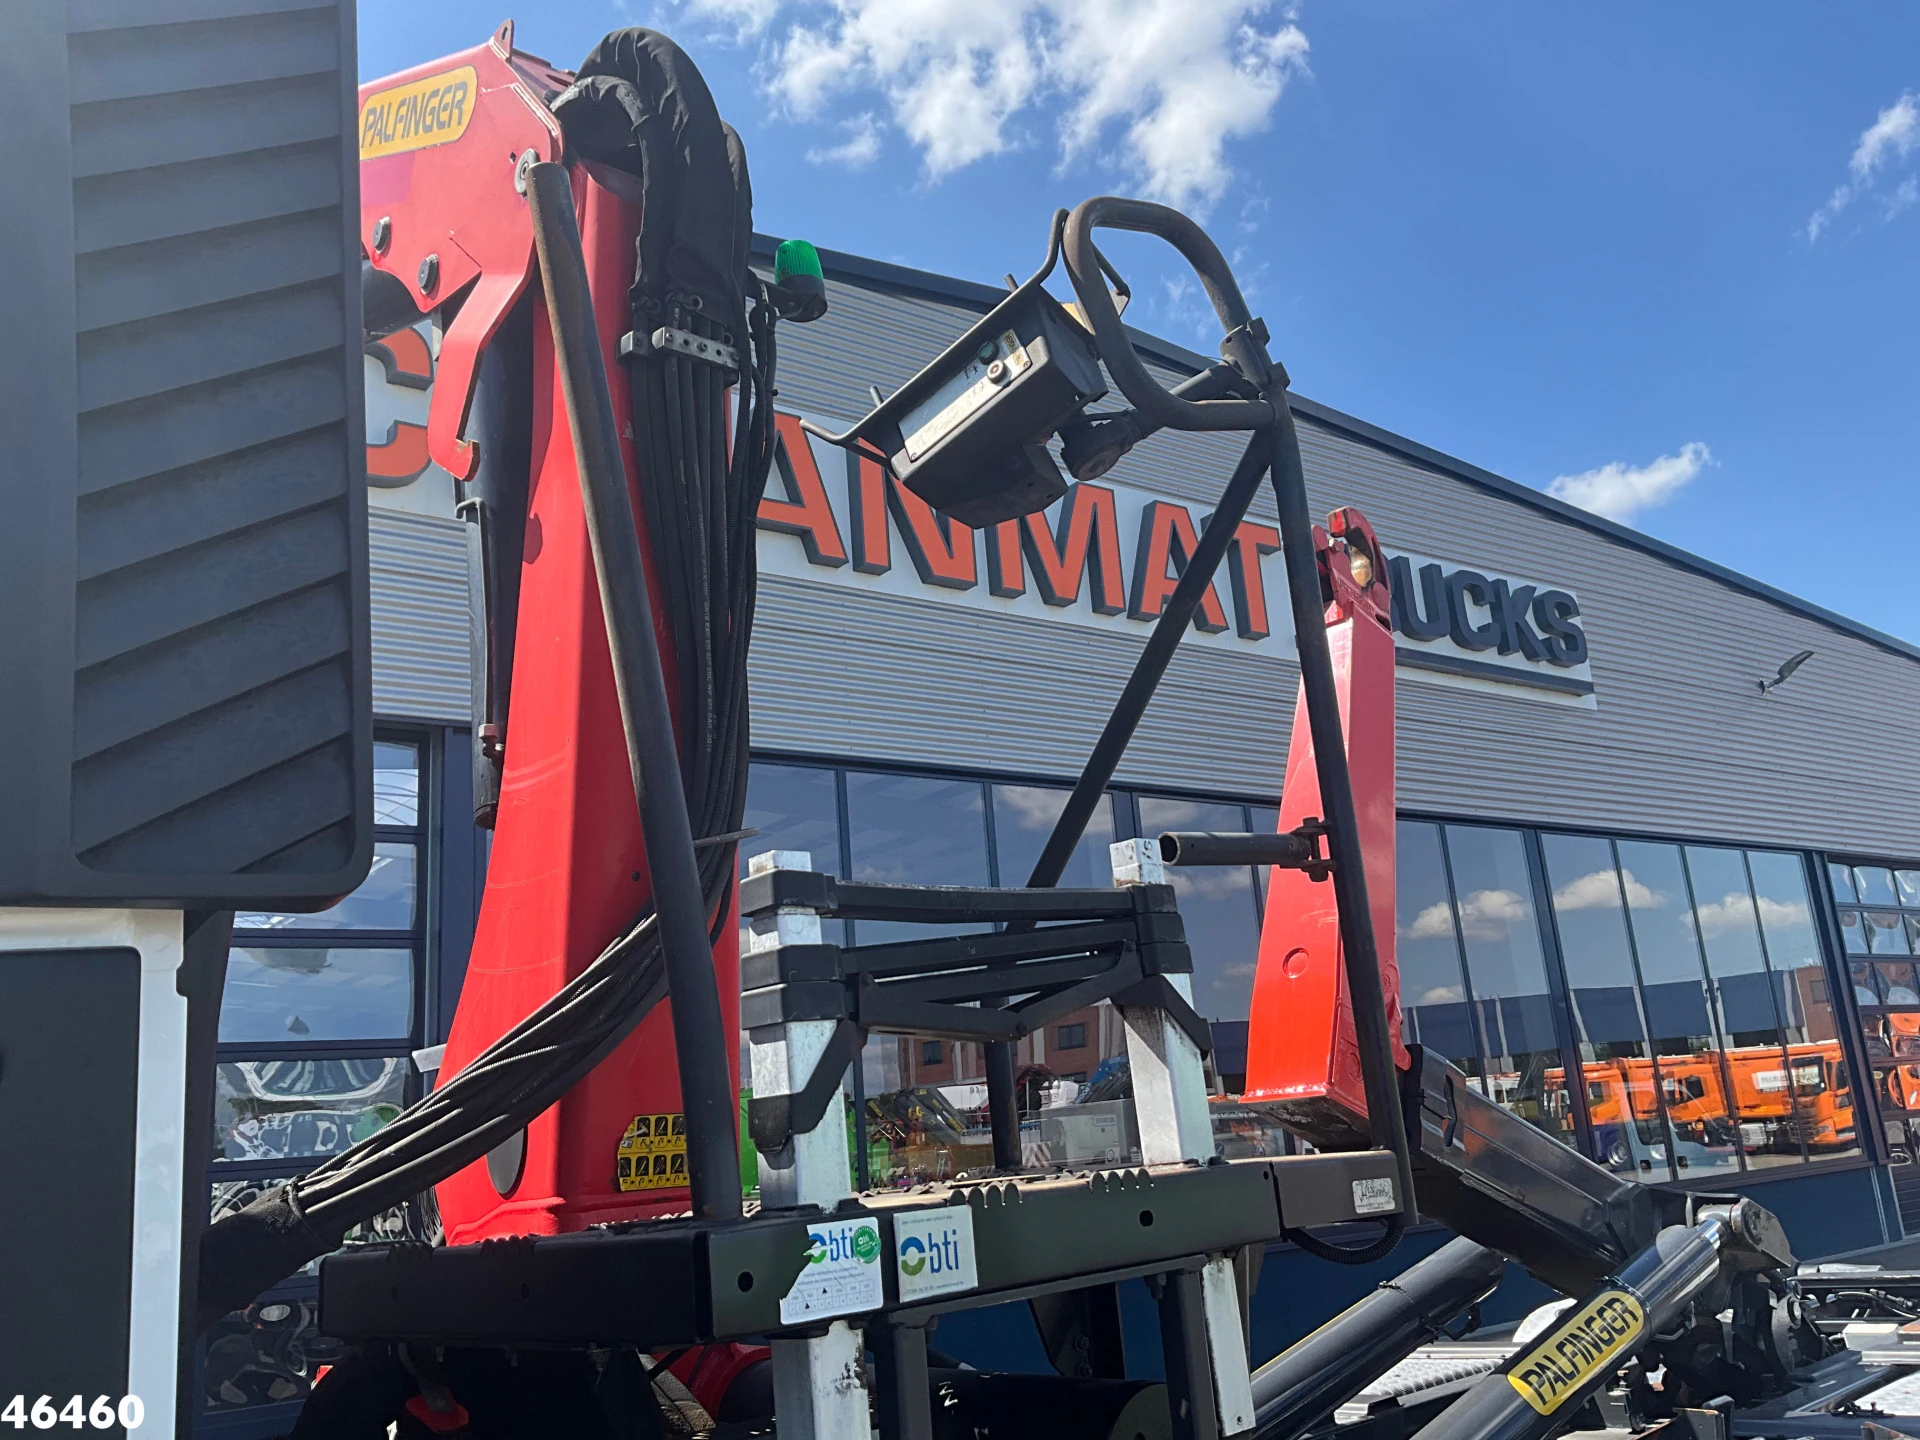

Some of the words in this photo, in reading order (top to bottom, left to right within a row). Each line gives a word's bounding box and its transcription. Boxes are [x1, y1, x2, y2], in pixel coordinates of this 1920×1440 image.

[360, 81, 468, 149] PALFINGER
[927, 1229, 960, 1274] bti
[1517, 1297, 1640, 1406] PALFINGER
